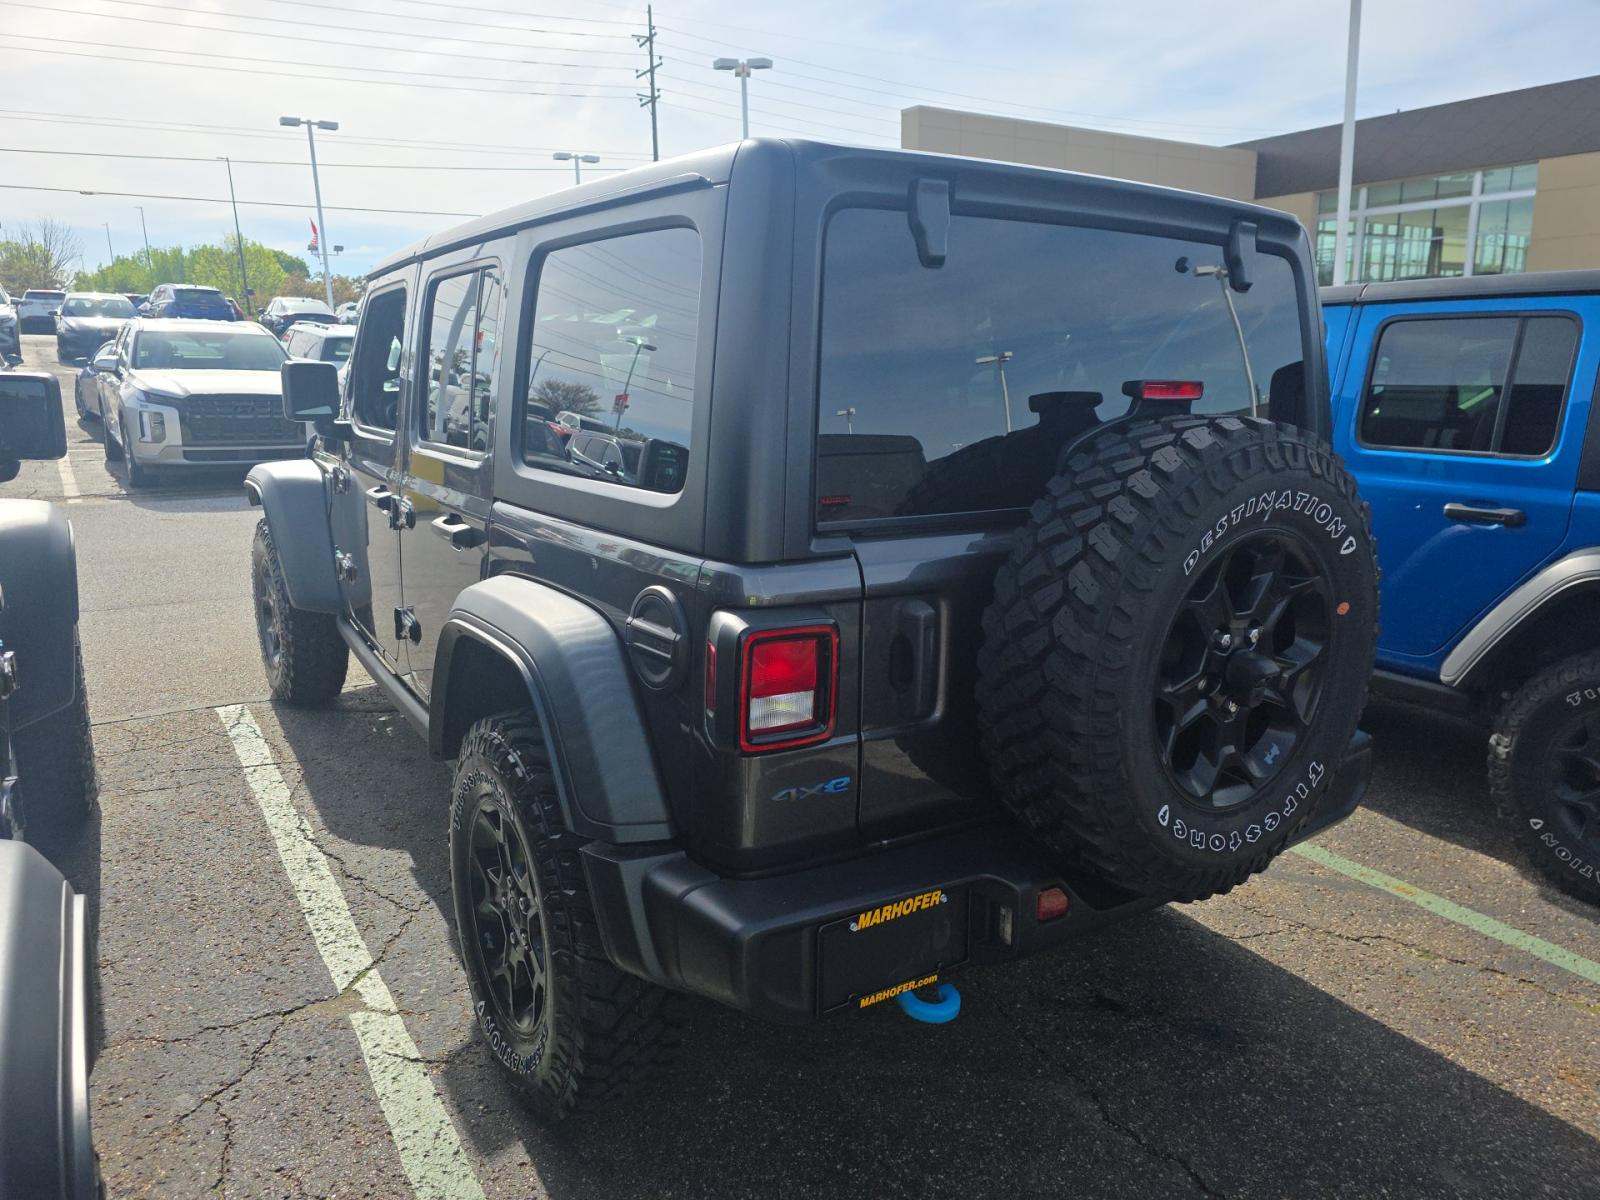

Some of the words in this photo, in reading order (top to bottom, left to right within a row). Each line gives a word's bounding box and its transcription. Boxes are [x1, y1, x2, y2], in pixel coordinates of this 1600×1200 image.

[1184, 491, 1346, 575] DESTINATION
[1174, 762, 1324, 851] Firestone
[857, 890, 942, 931] MARHOFER
[860, 975, 938, 1009] MARHOFER.com
